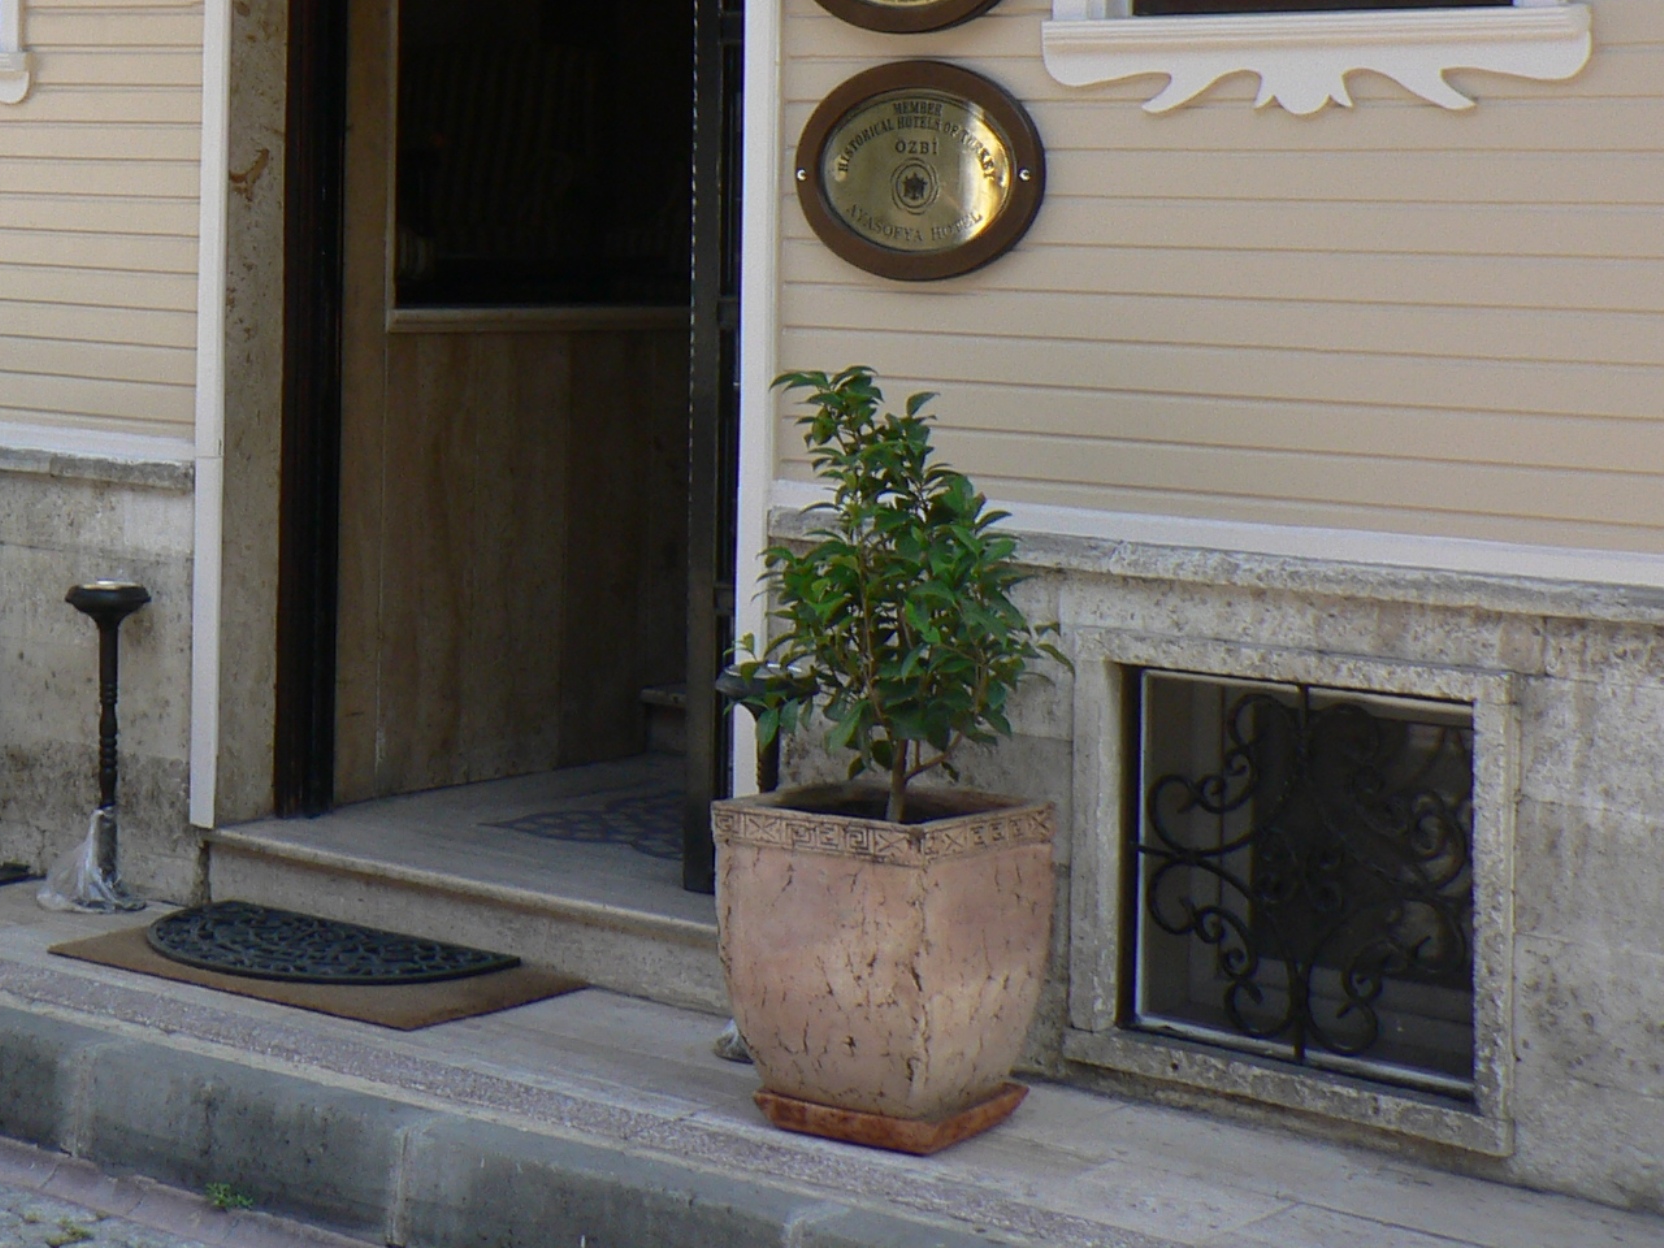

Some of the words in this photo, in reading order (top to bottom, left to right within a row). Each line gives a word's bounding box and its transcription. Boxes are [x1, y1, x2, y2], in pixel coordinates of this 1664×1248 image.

[893, 102, 943, 115] MEMBER
[838, 119, 895, 173] HISTORICAL
[897, 116, 941, 131] HOTELS
[943, 122, 959, 137] OF
[959, 128, 996, 179] TURKEY
[846, 204, 924, 242] AYASOFYA
[931, 212, 983, 241] HOTEL
